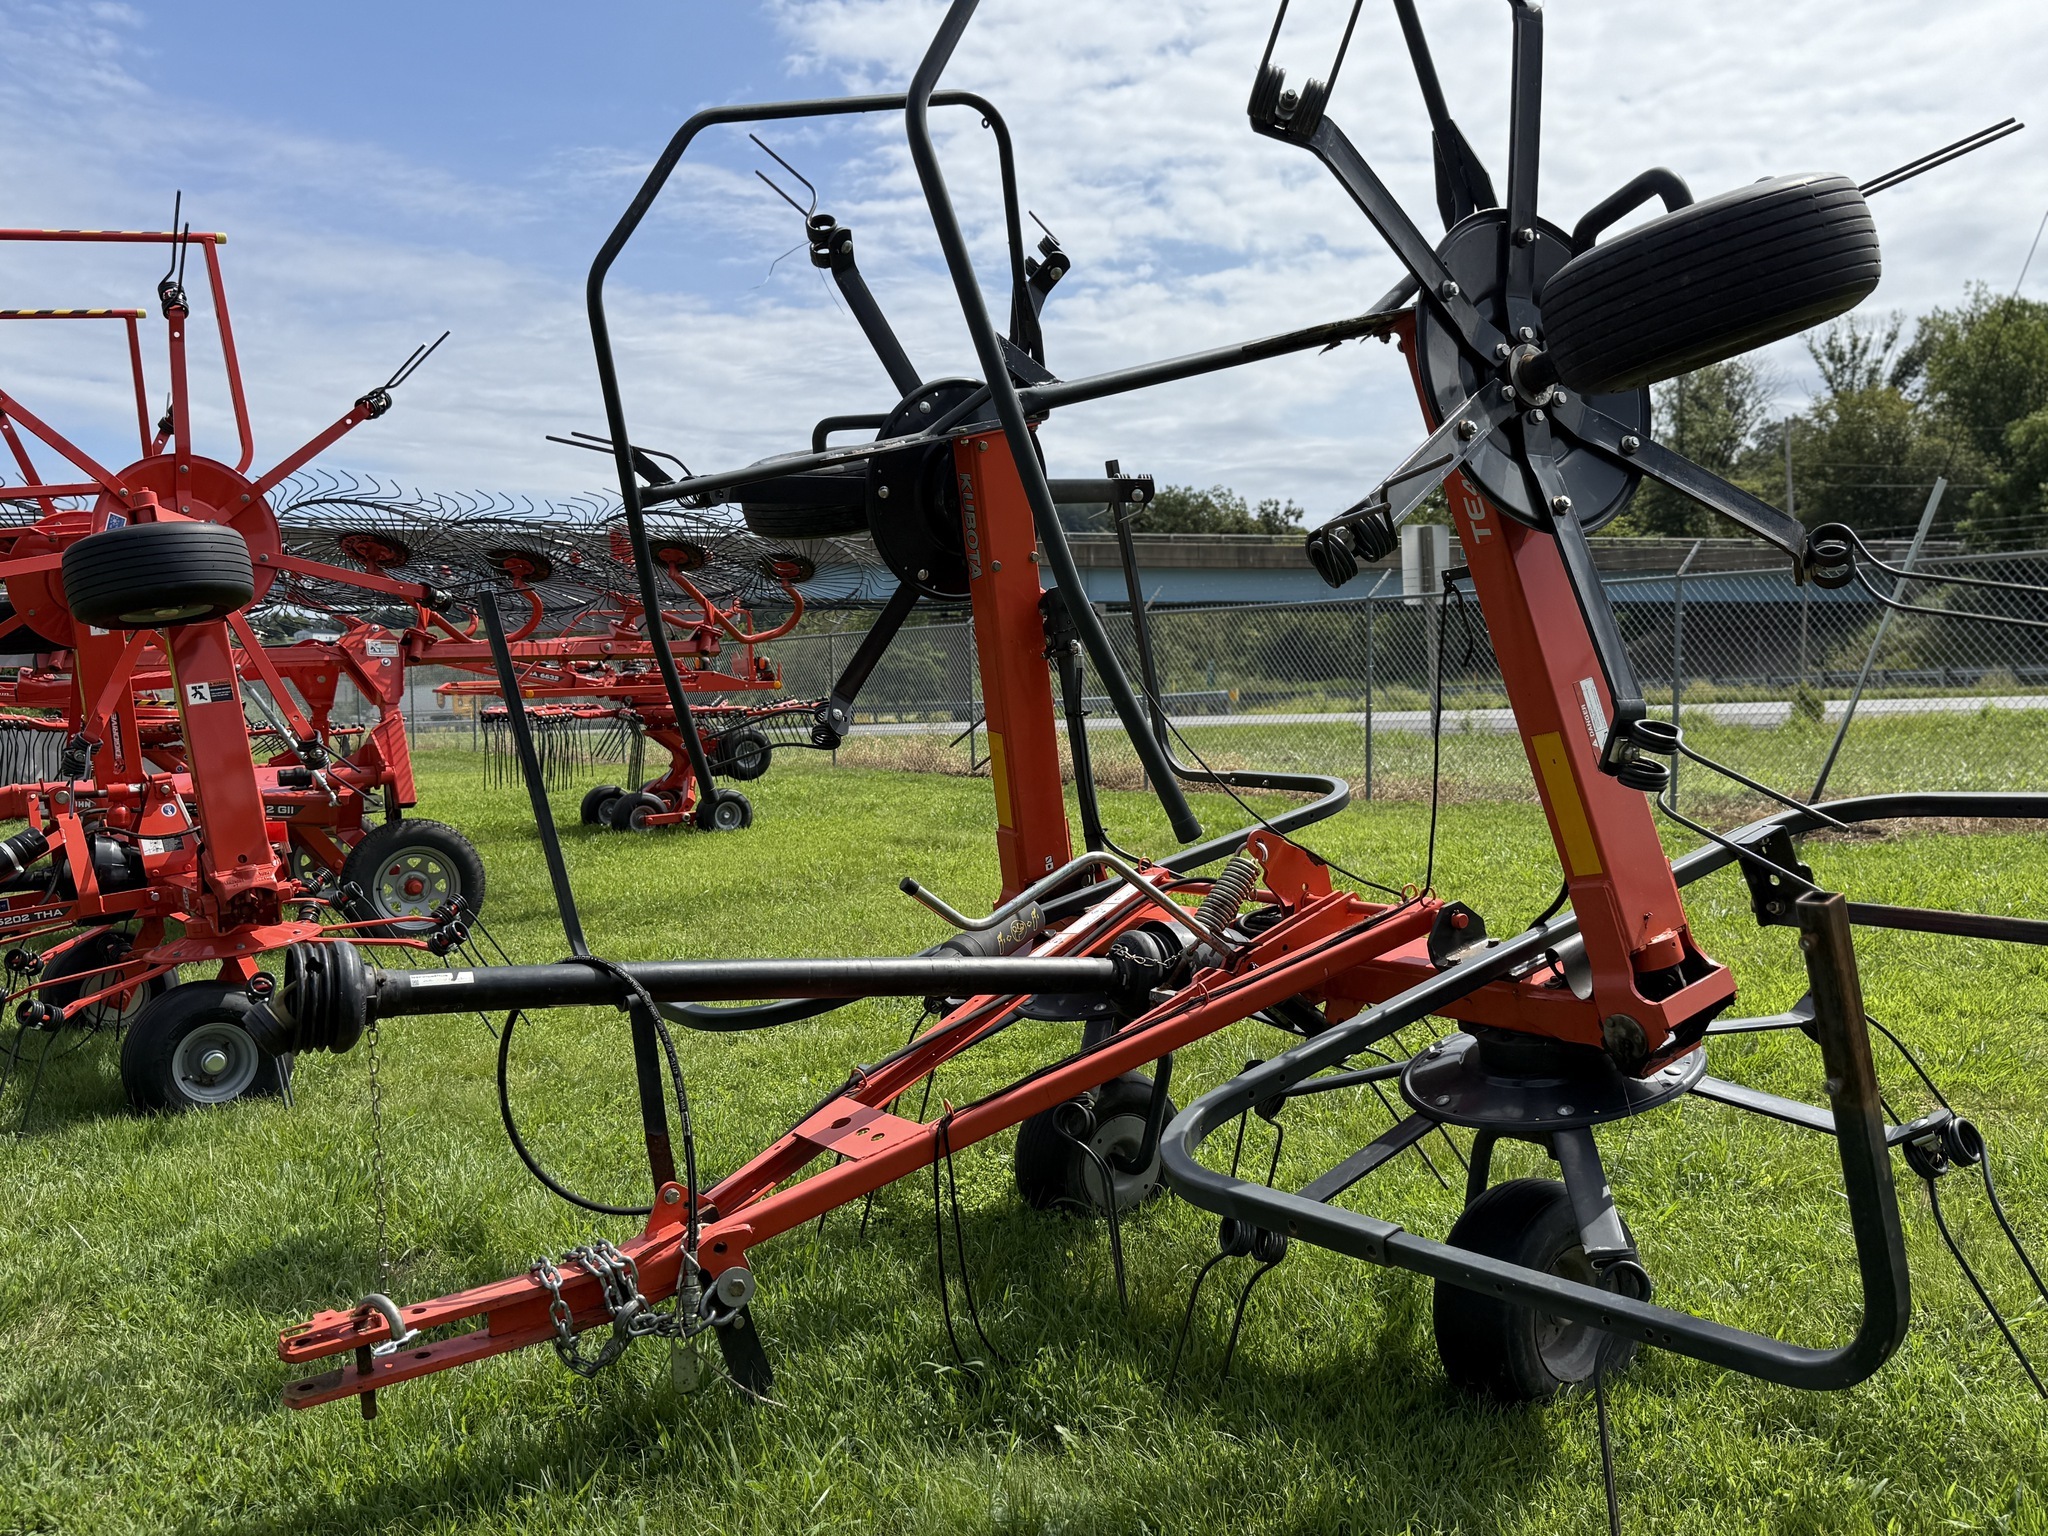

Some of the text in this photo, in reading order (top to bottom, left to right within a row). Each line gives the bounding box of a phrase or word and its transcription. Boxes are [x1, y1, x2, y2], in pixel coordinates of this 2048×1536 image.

[959, 473, 982, 580] KUBOTA
[1461, 479, 1492, 544] TE4
[110, 713, 122, 759] DIGIDRIVE
[1581, 704, 1595, 738] DANGER
[34, 908, 63, 920] THA
